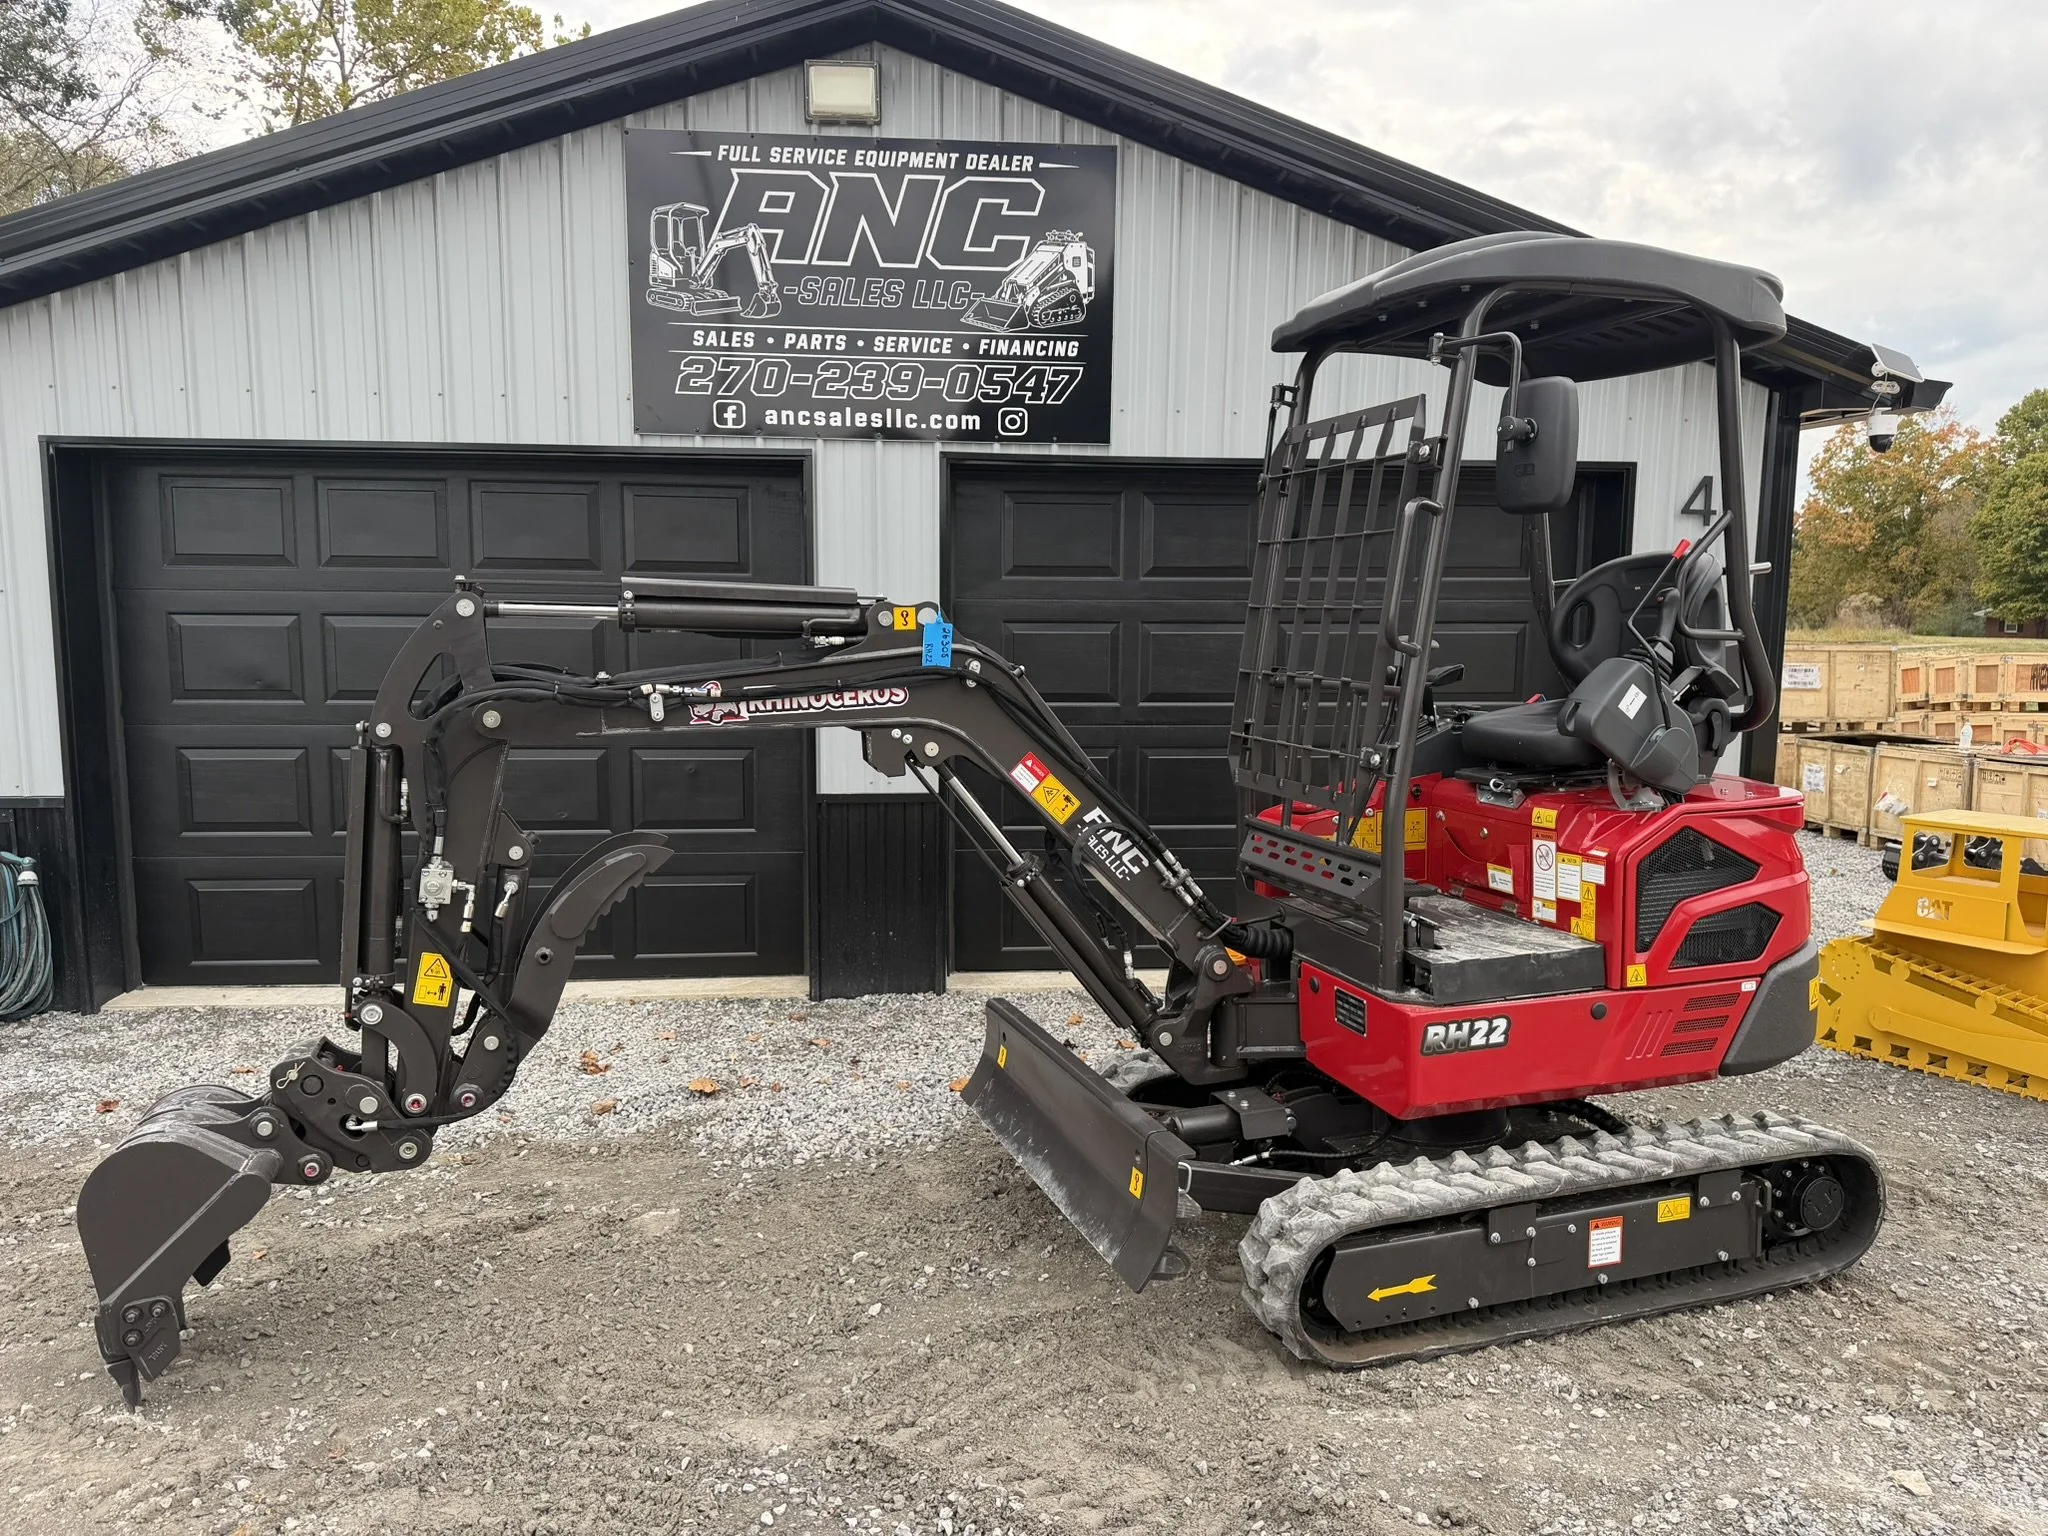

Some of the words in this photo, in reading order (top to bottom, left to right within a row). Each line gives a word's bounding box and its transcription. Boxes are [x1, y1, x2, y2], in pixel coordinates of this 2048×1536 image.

[717, 144, 761, 163] FULL
[769, 146, 848, 166] SERVICE
[854, 149, 960, 169] EQUIPMENT
[965, 153, 1034, 172] DEALER
[707, 168, 1046, 271] ANC
[692, 329, 755, 348] SALES
[783, 332, 847, 351] PARTS
[873, 335, 953, 354] SERVICE
[978, 338, 1080, 357] FINANCING
[674, 355, 1084, 405] 270-239-0547
[764, 406, 981, 430] ancsalesllc.com
[1681, 475, 1717, 527] 4
[925, 643, 934, 664] RH22
[1422, 1016, 1509, 1055] RH22
